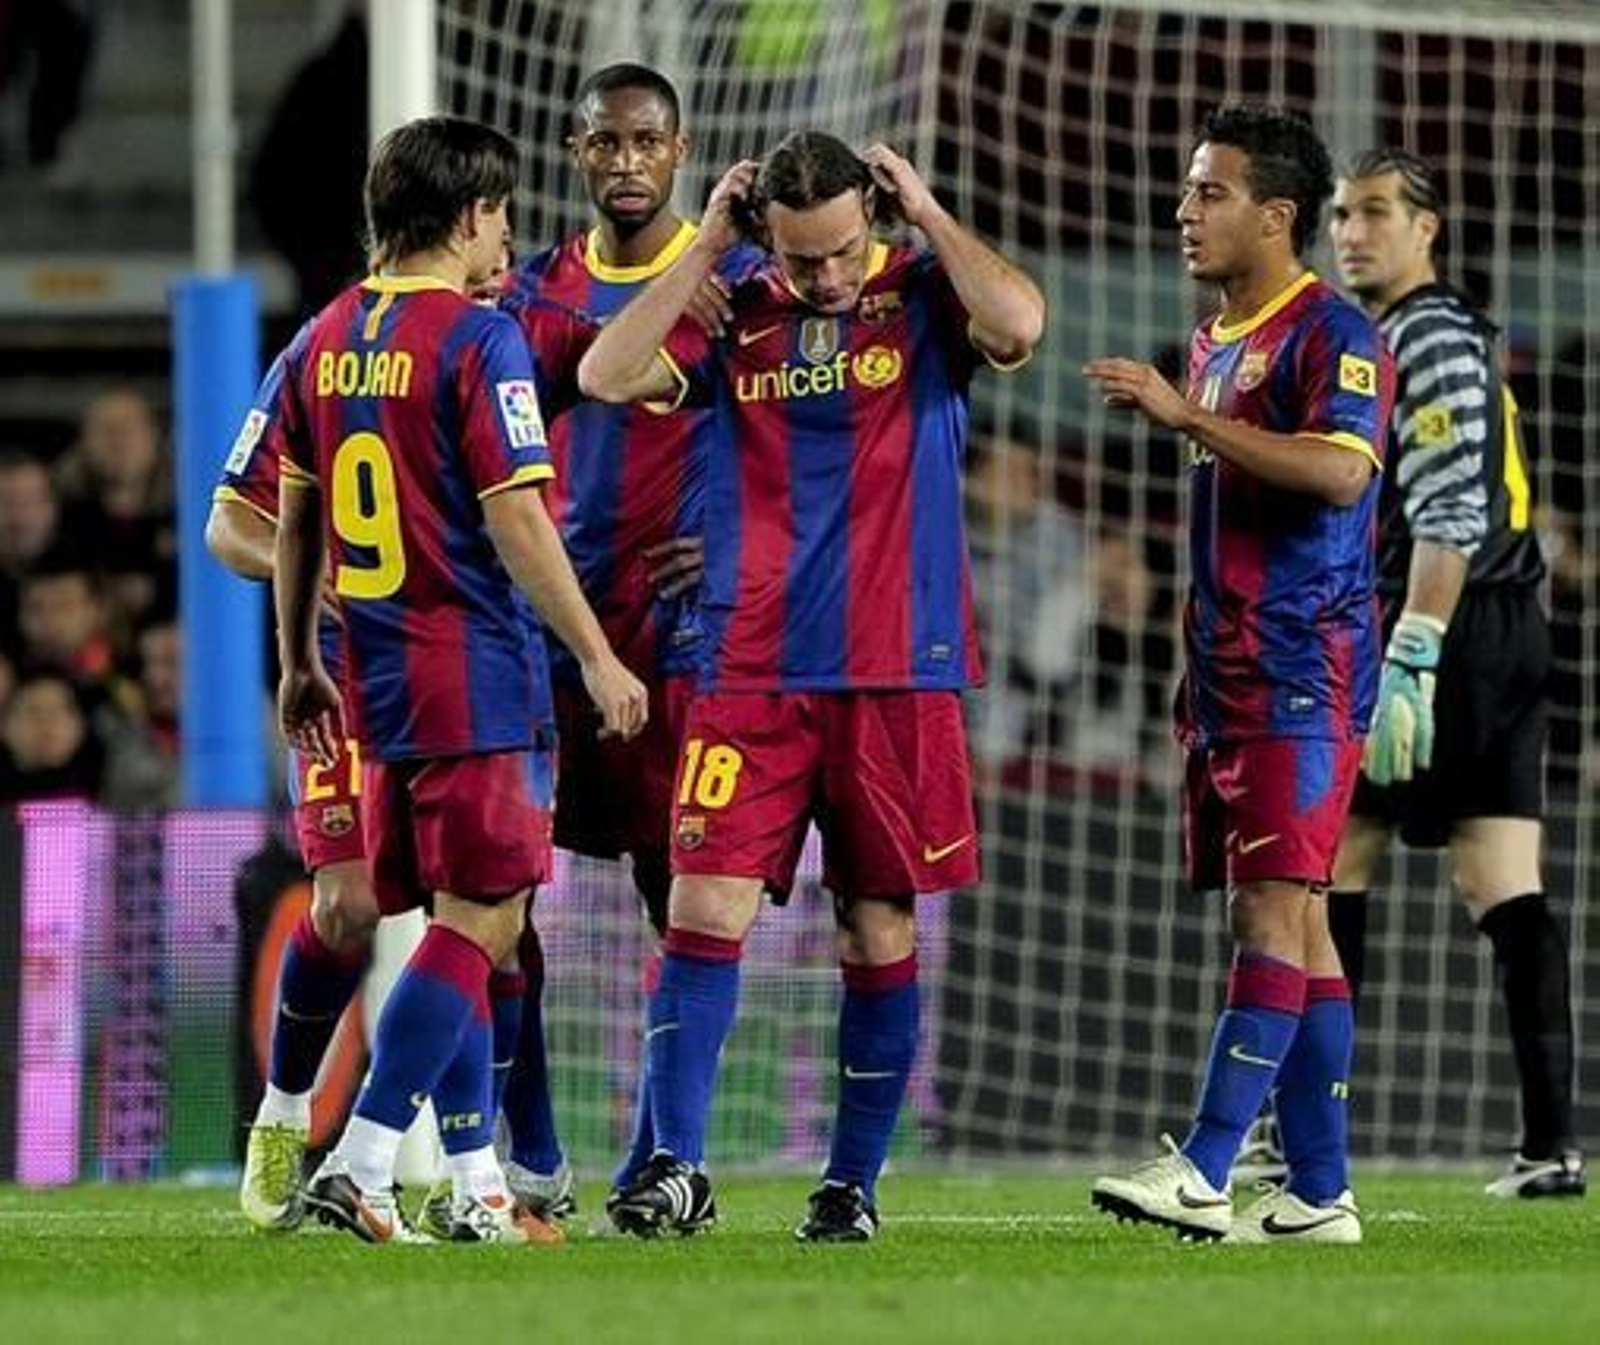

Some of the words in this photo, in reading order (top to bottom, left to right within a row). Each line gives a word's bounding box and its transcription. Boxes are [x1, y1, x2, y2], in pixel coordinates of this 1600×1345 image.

[316, 351, 413, 397] BOJAN
[736, 350, 849, 401] unicef
[332, 431, 406, 599] 9
[679, 737, 743, 809] 18
